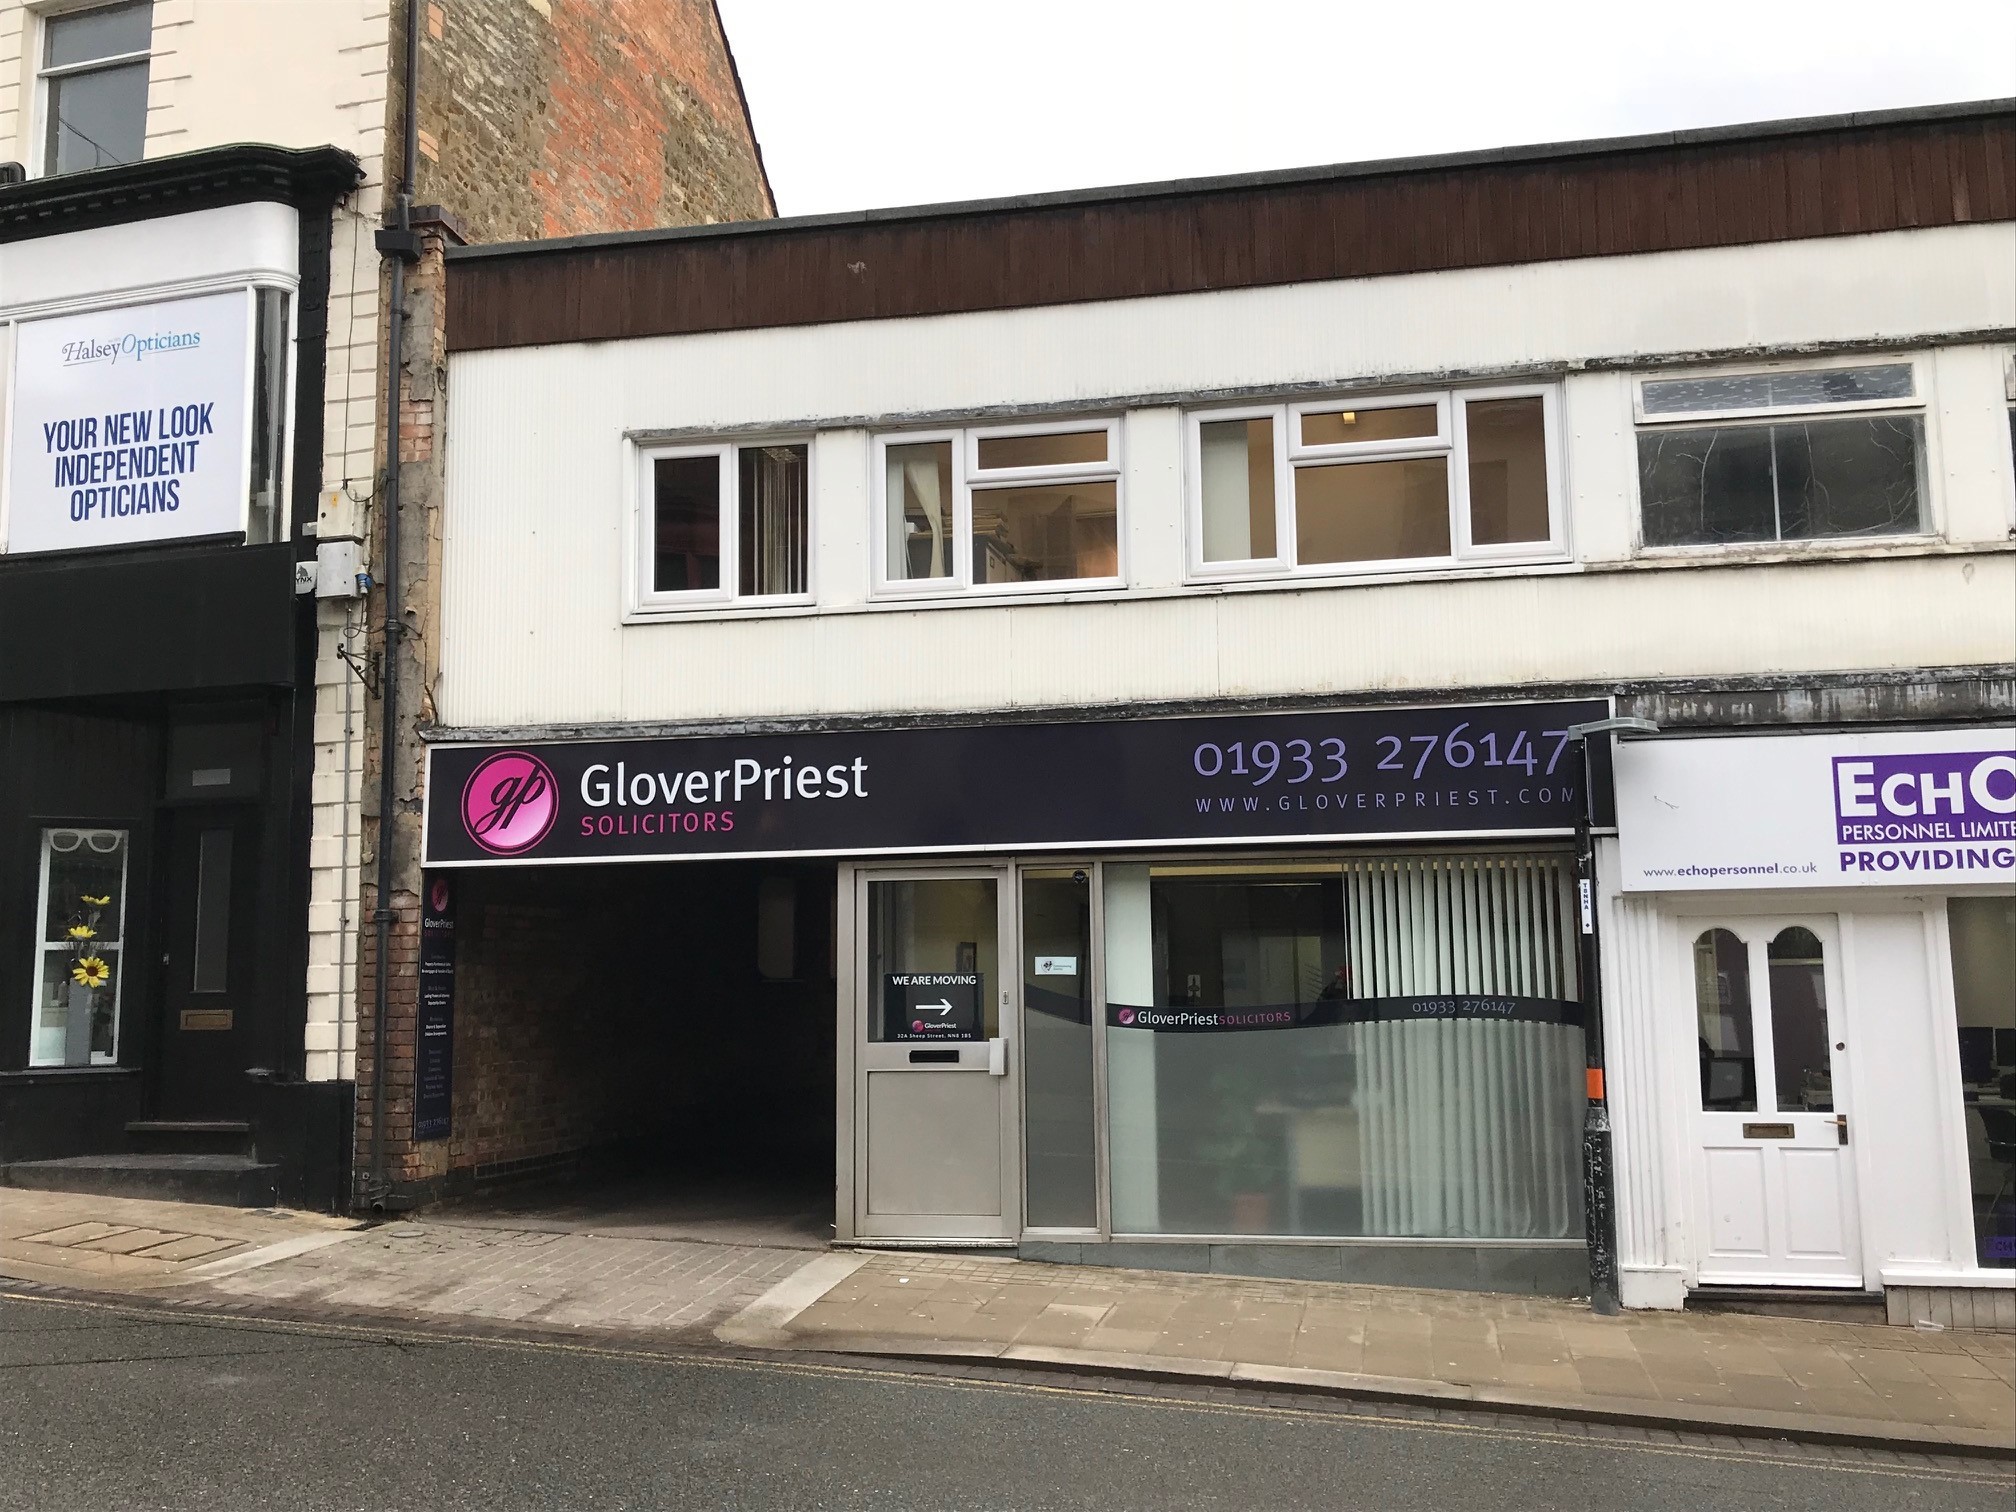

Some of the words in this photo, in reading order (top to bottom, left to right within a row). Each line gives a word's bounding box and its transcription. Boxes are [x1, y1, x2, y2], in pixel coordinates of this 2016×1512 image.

[44, 417, 98, 453] YOUR
[104, 410, 152, 446] NEW
[158, 402, 214, 439] LOOK
[55, 440, 199, 487] INDEPENDENT
[70, 478, 180, 521] OPTICIANS
[1193, 737, 1348, 786] 01933
[1375, 722, 1570, 780] 276147
[580, 756, 868, 807] GloverPriest
[580, 811, 735, 836] SOLICITORS
[1842, 822, 1955, 841] PERSONNEL
[1961, 820, 2016, 838] LIMITE
[1643, 861, 1818, 878] www.echopersonnel.co.uk
[1840, 847, 2015, 872] PROVIDING
[424, 917, 454, 929] GloverPriest
[892, 976, 909, 985] WE
[911, 975, 931, 985] ARE
[933, 975, 977, 985] MOVING
[1412, 1001, 1456, 1015] 01933
[1462, 999, 1516, 1015] 276147
